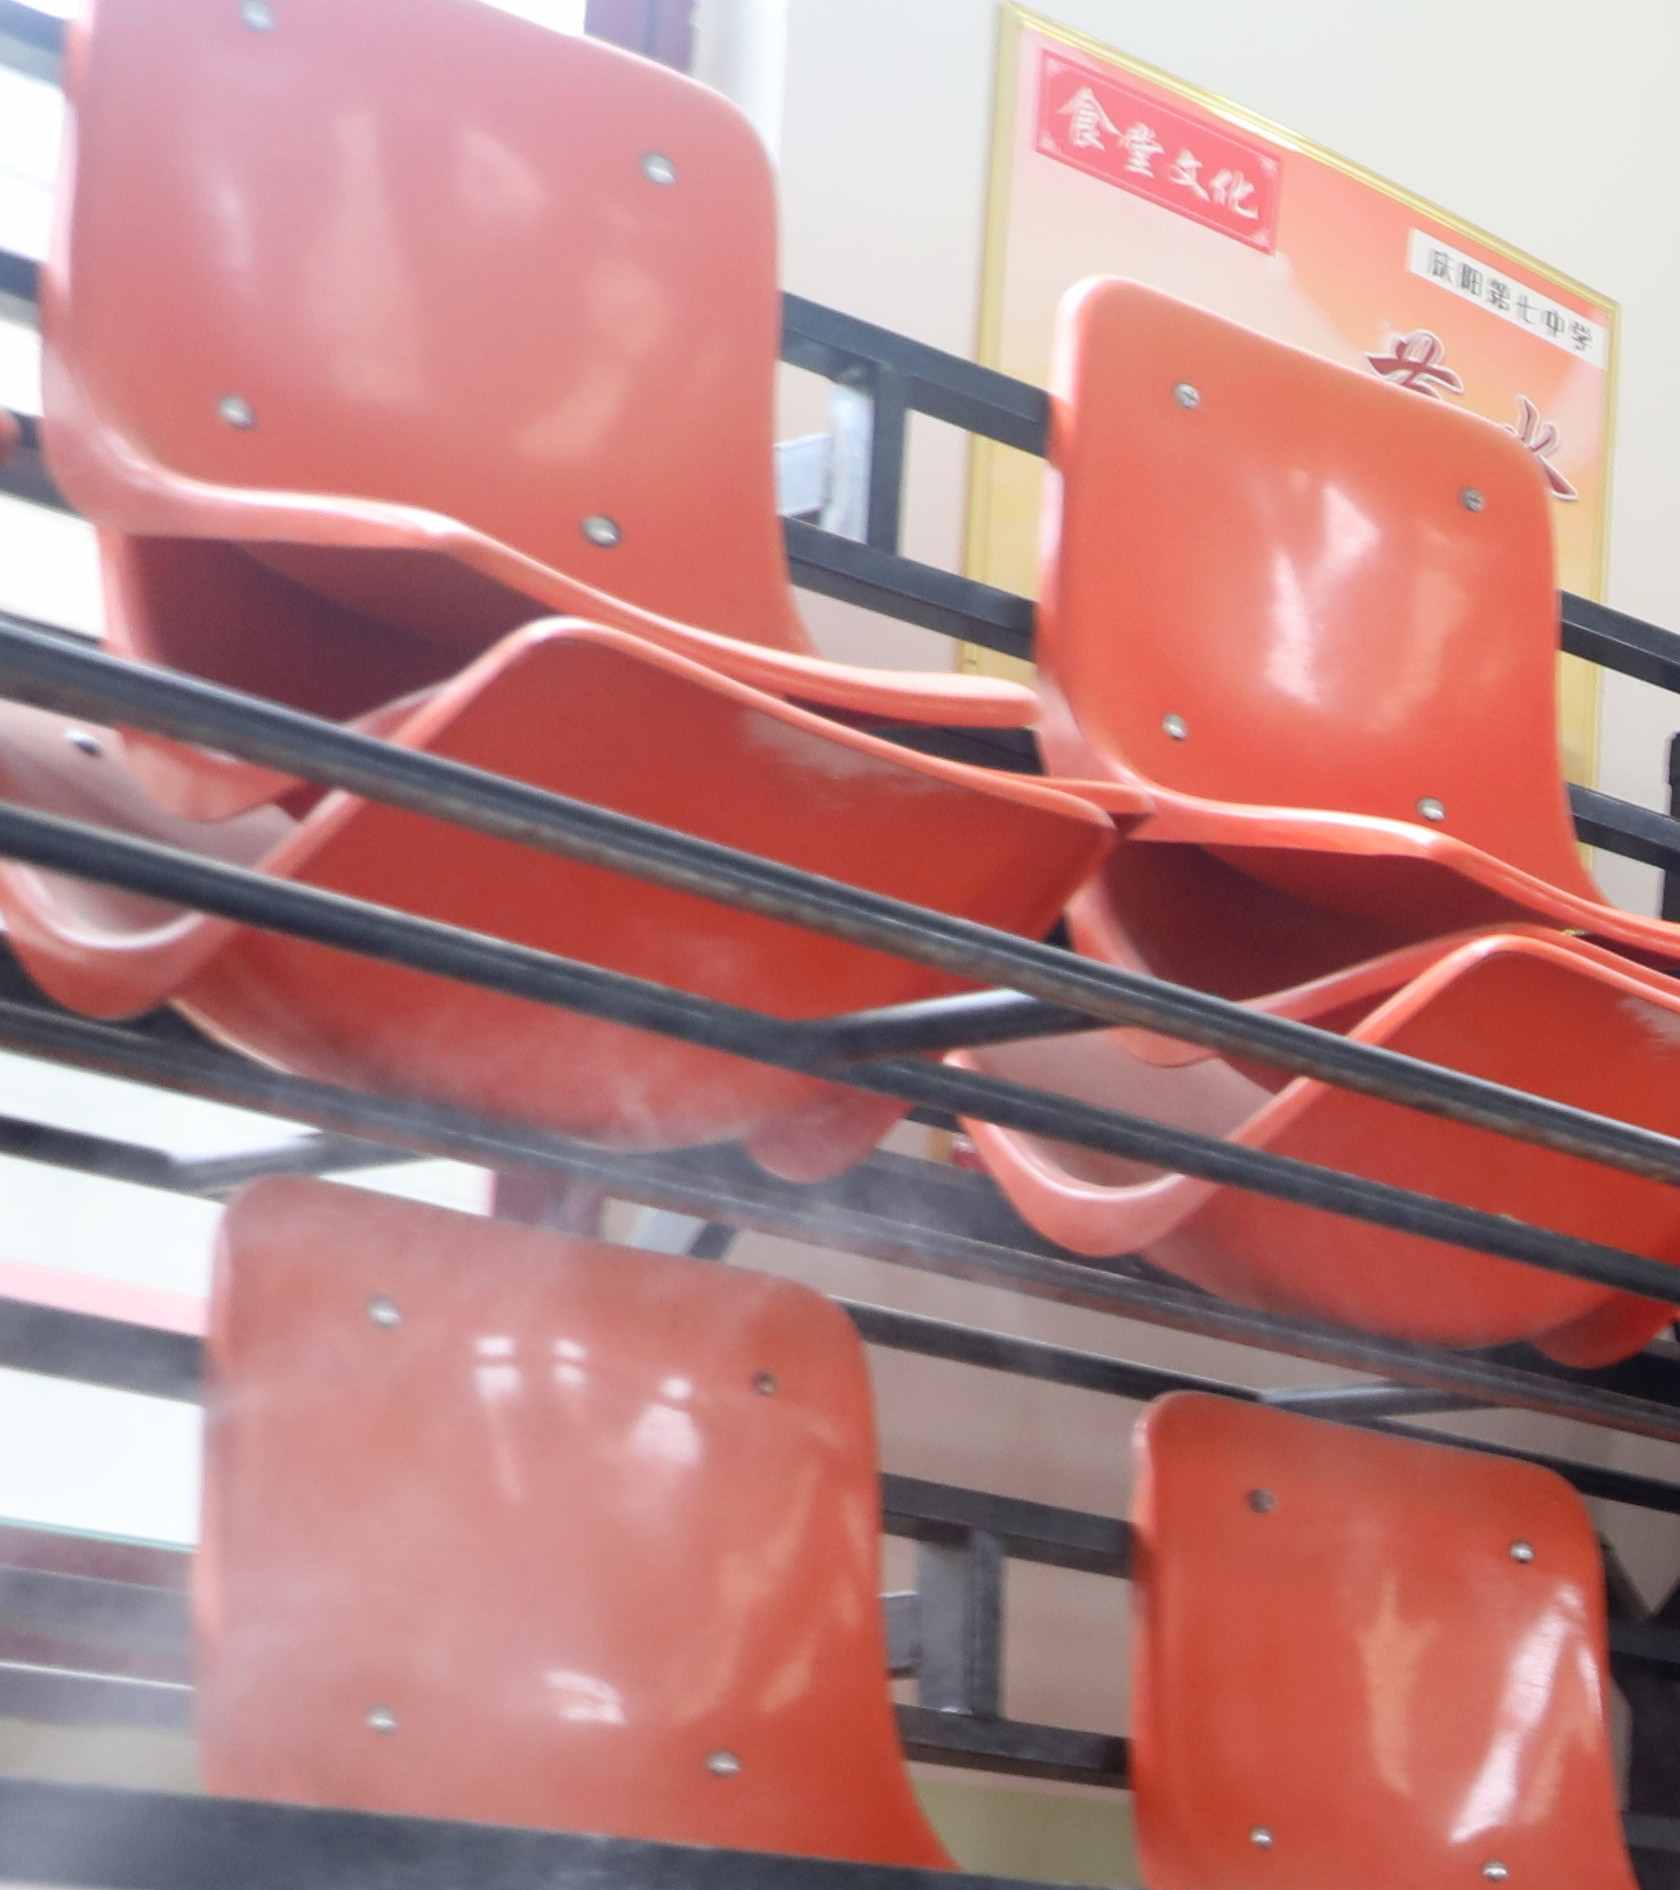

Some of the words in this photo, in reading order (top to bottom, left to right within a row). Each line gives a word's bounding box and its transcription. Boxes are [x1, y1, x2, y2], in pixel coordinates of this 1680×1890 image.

[1056, 86, 1260, 220] 食堂文化
[1427, 248, 1592, 351] 庆阳第七中学
